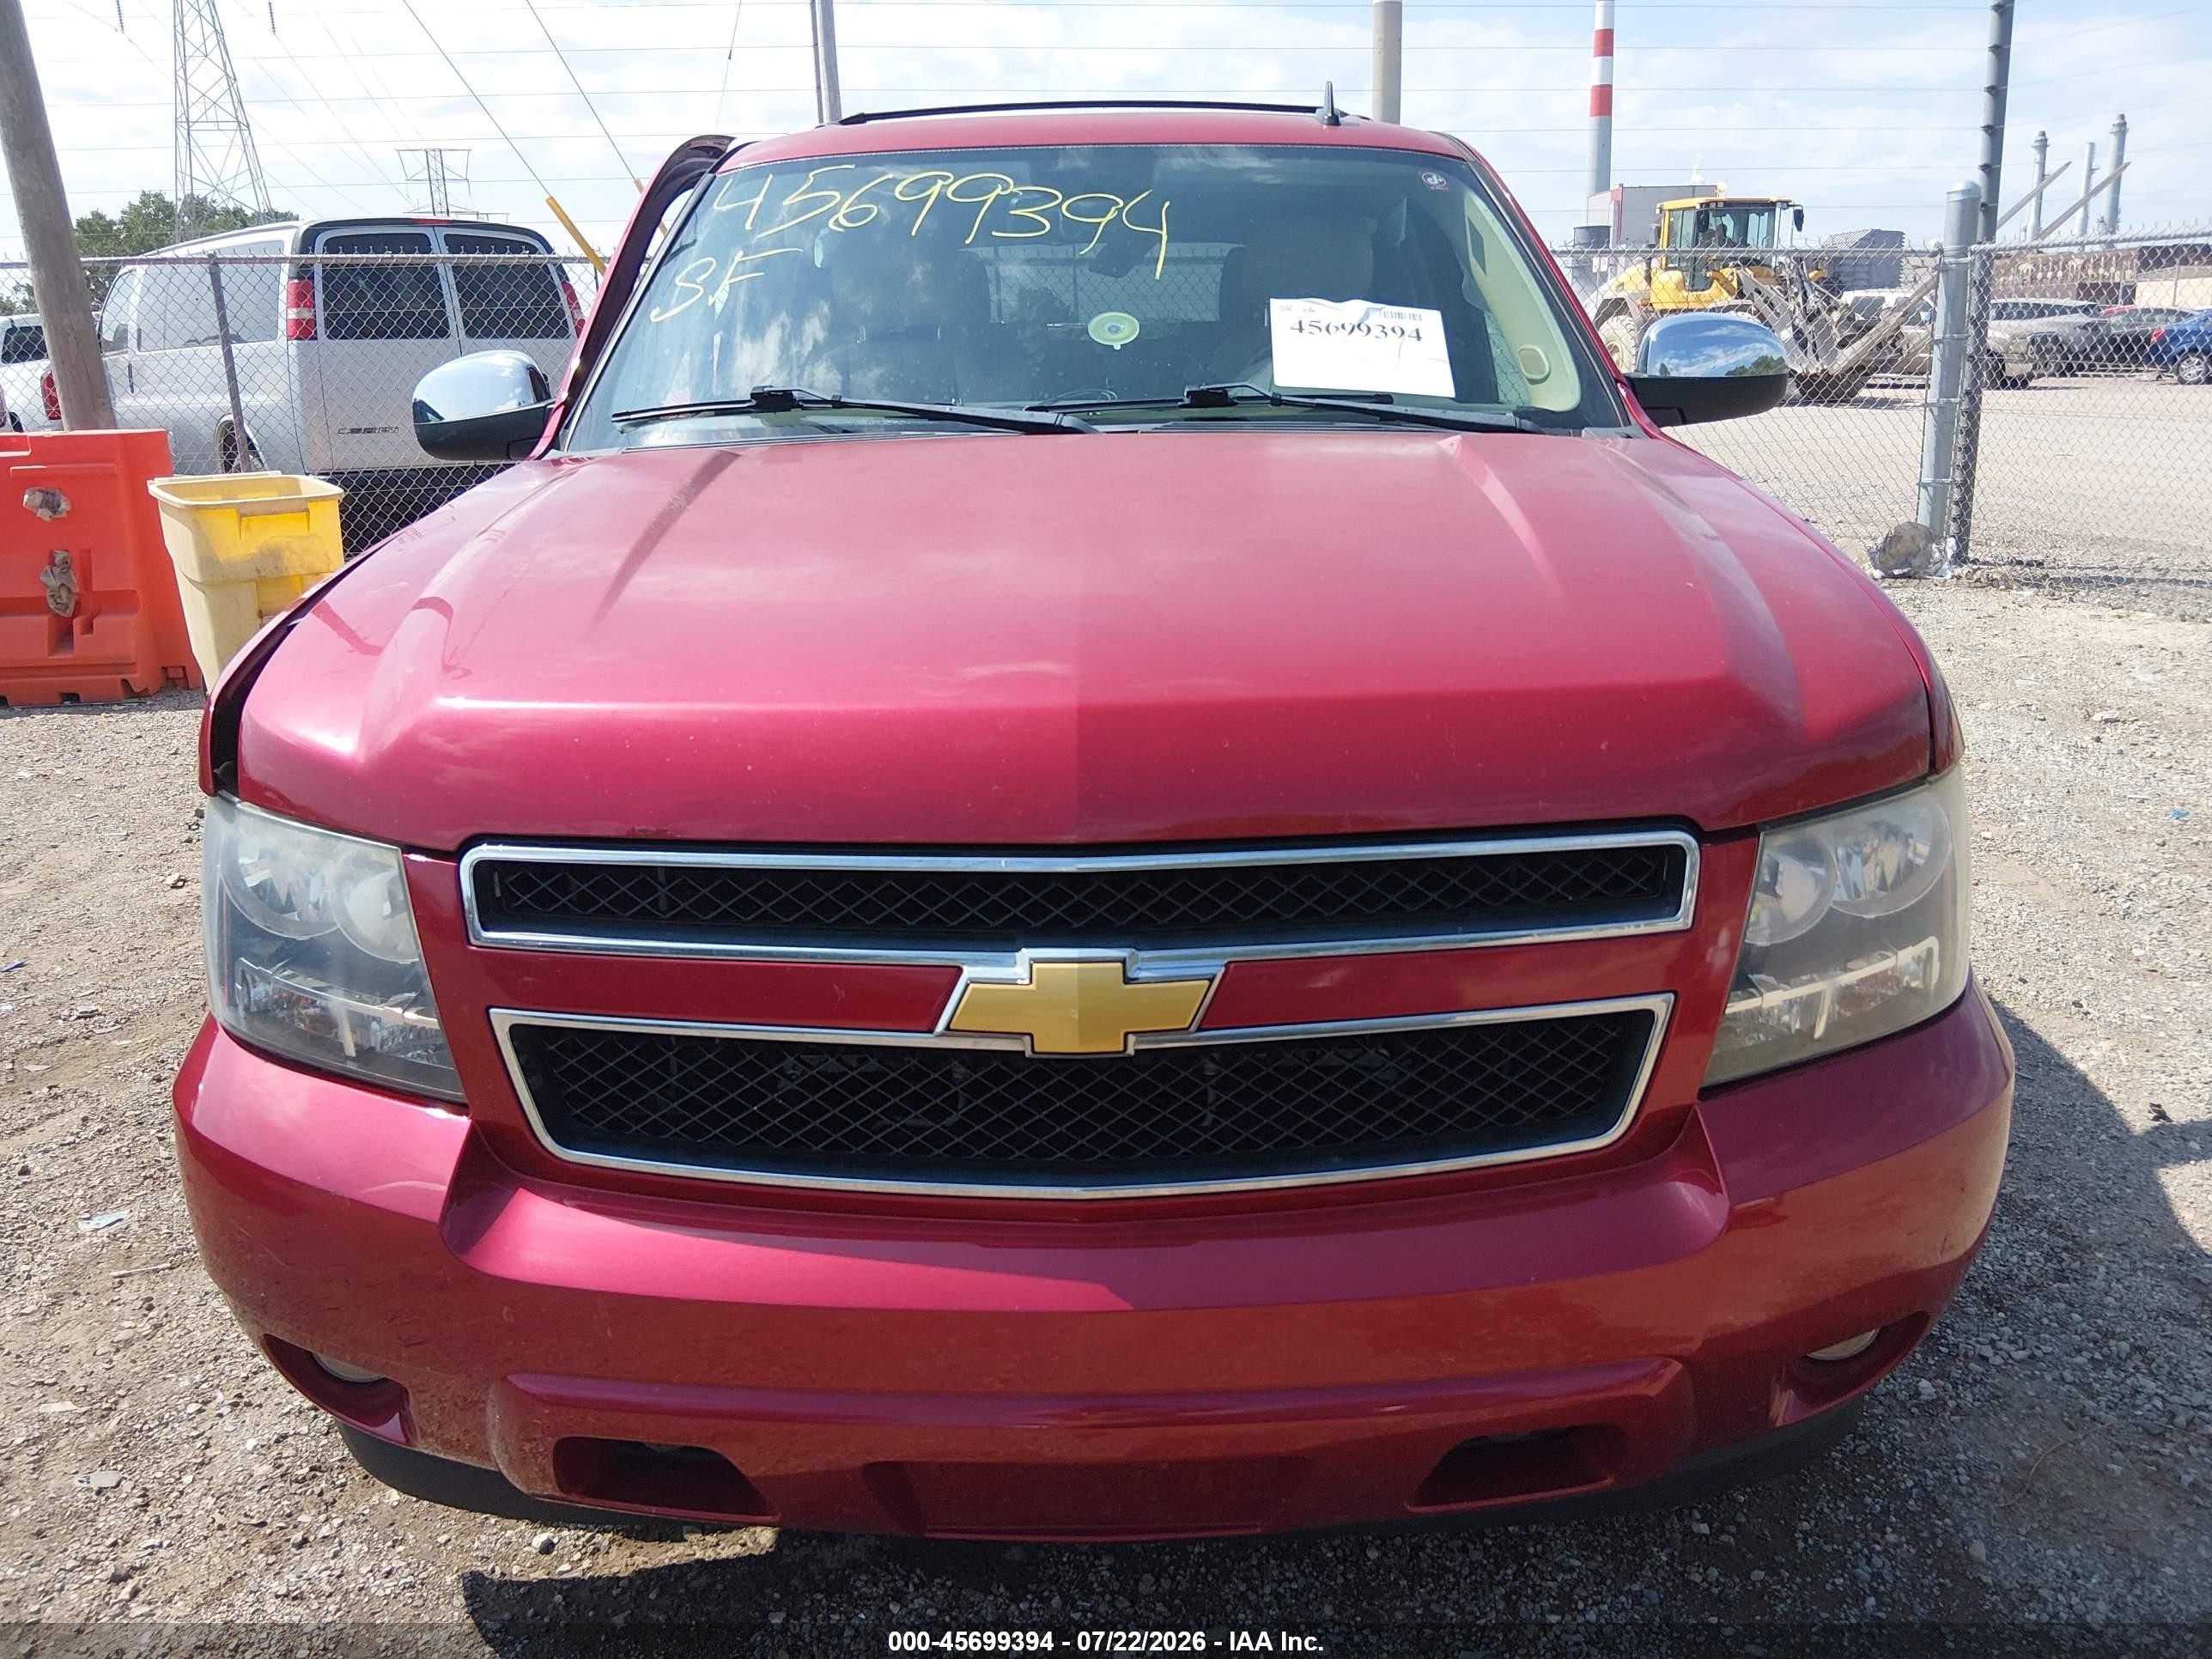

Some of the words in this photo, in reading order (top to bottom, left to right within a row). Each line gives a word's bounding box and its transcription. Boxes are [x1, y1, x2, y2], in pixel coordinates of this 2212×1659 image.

[715, 164, 1170, 279] 45699394
[650, 247, 804, 322] SF
[1290, 319, 1423, 342] 45699394
